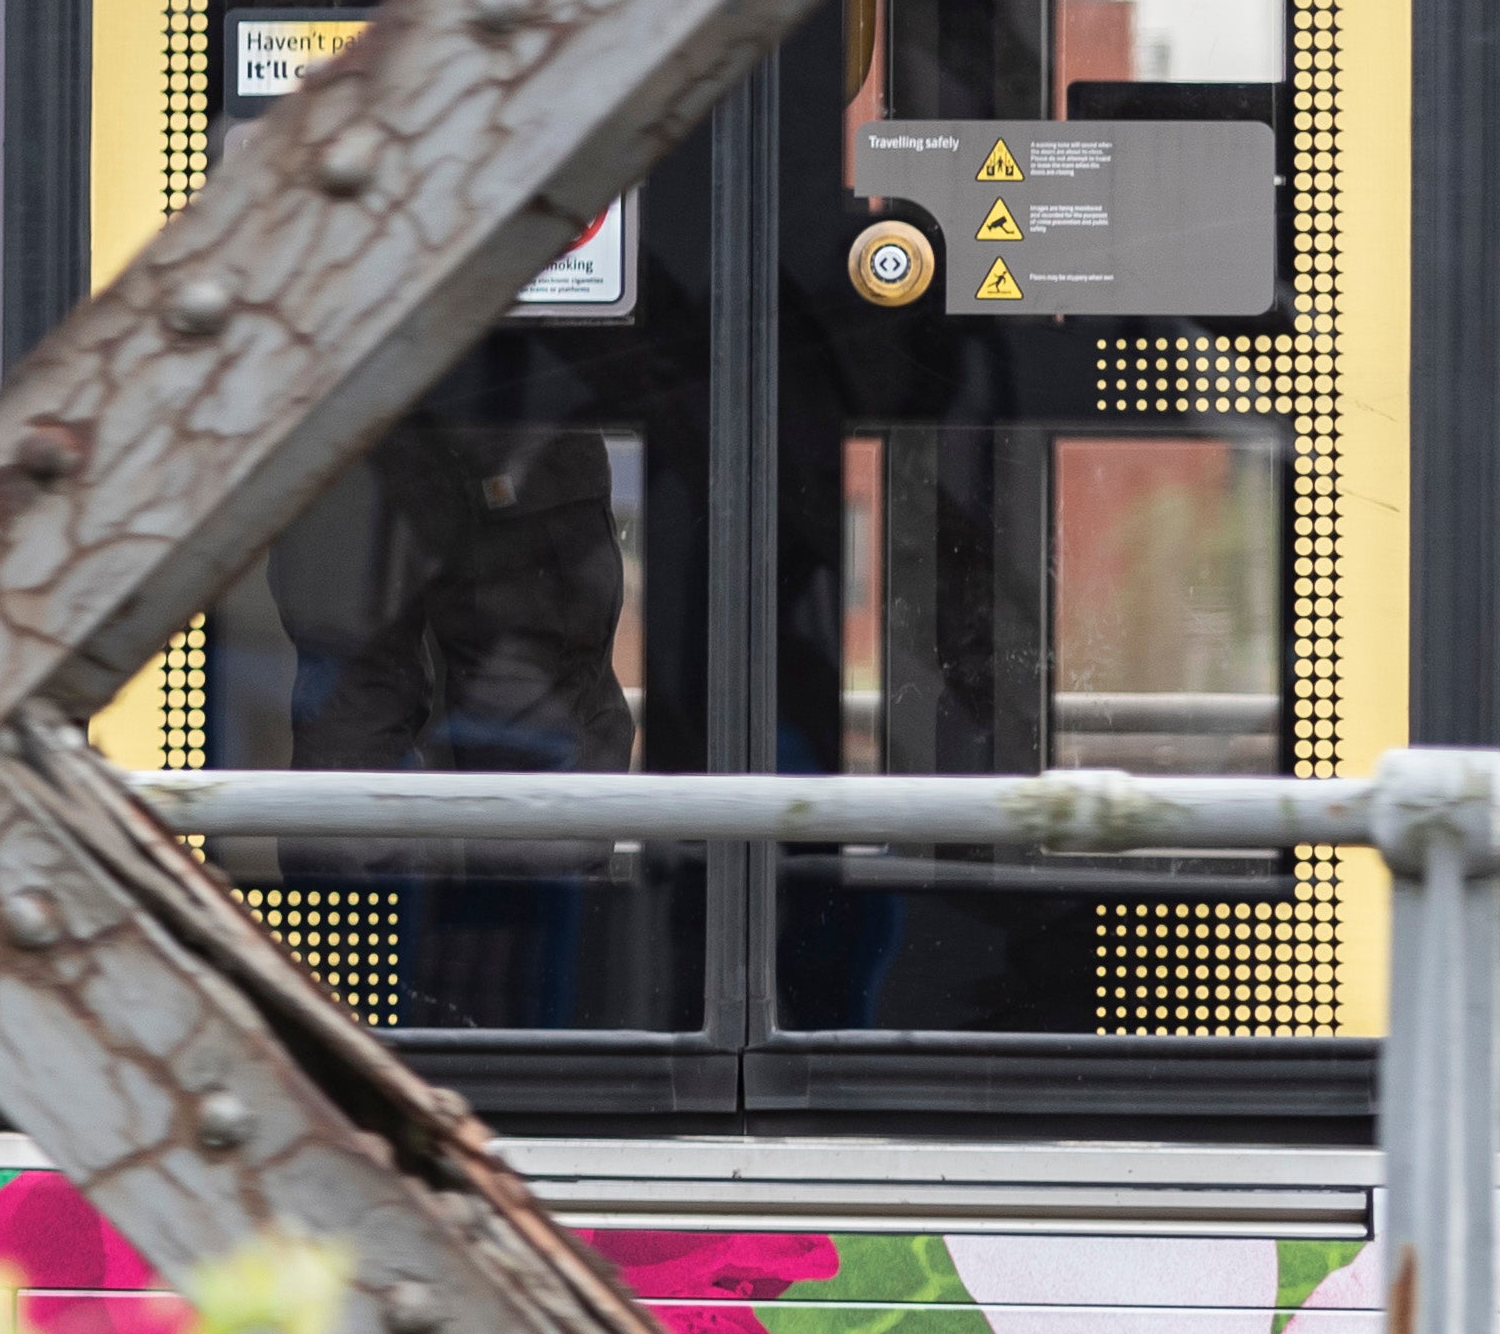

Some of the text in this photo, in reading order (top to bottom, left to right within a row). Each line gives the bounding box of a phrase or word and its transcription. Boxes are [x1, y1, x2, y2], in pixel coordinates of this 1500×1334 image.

[247, 31, 362, 55] Haven't pai
[247, 61, 288, 79] It'll
[868, 135, 960, 152] Travelling safely
[544, 257, 594, 274] moking
